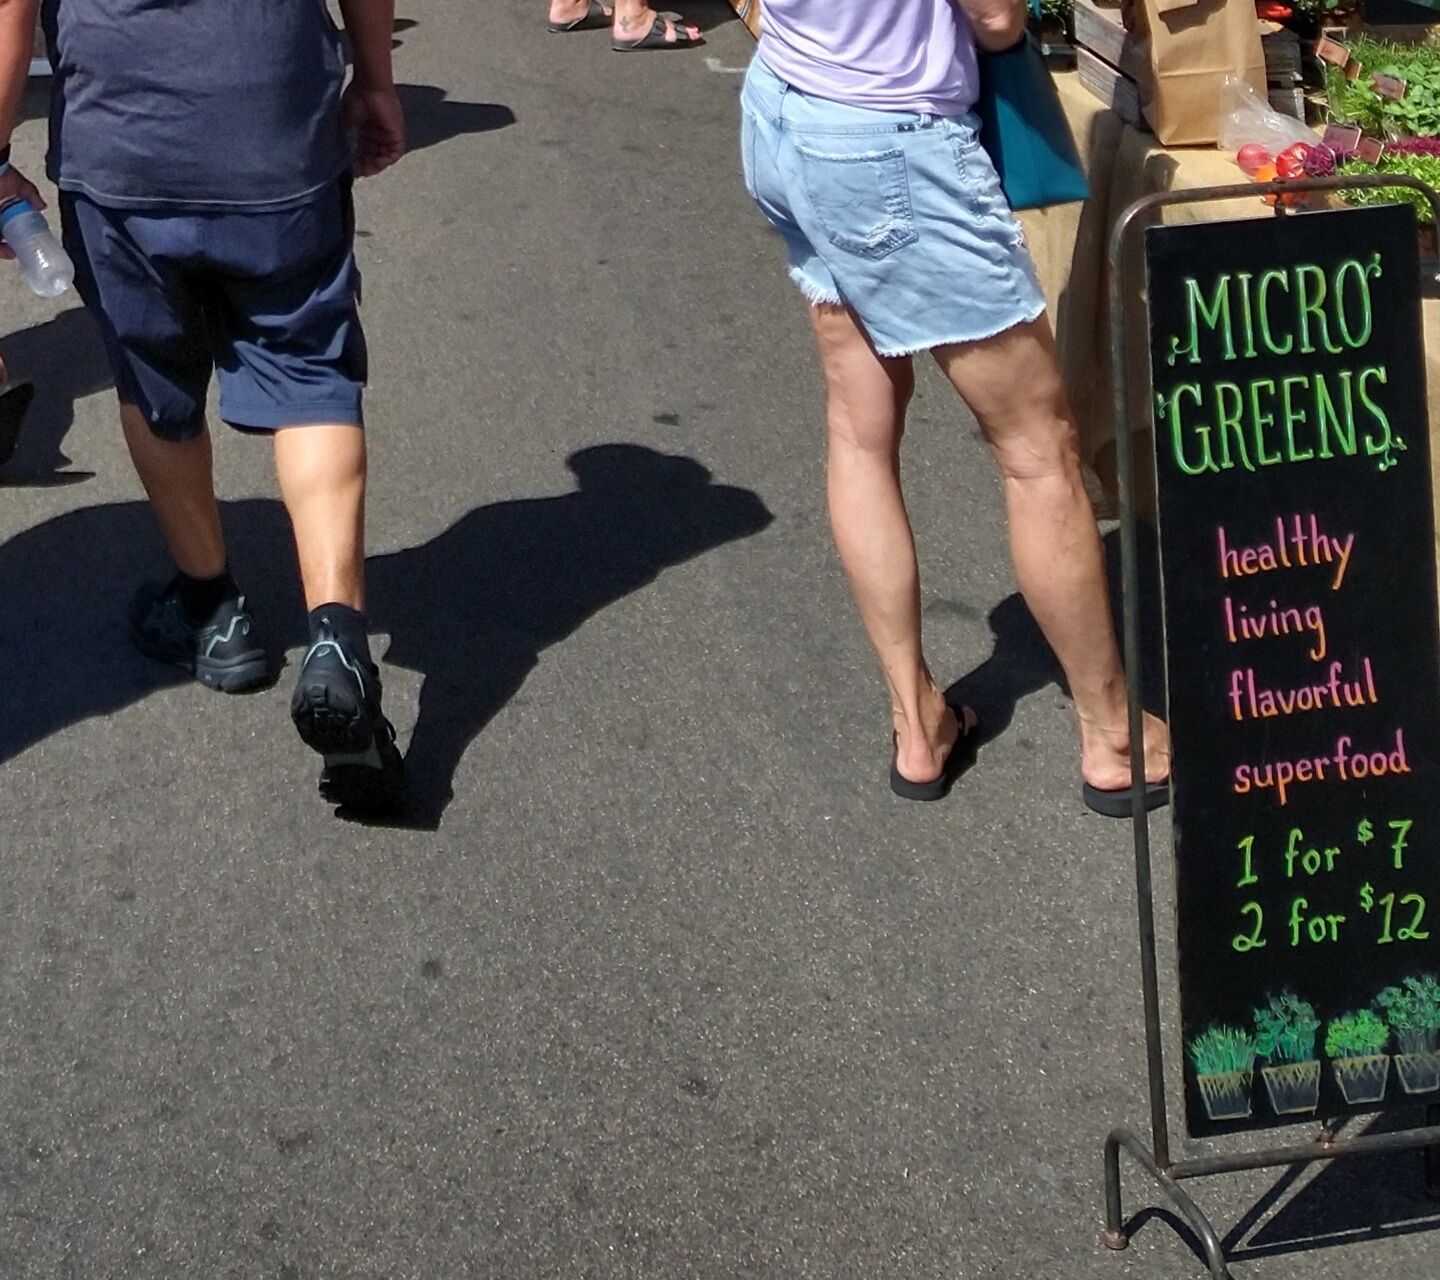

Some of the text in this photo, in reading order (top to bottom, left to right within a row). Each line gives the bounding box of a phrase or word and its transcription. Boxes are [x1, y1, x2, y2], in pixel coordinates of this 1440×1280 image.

[1172, 256, 1380, 365] MICRO
[1164, 366, 1400, 476] GREENS
[1218, 513, 1355, 591] healthy
[1224, 597, 1327, 661] living
[1228, 657, 1378, 721] flavorful
[1233, 728, 1411, 806] superfood
[1236, 835, 1259, 888] 1
[1284, 828, 1341, 878] for
[1232, 883, 1431, 953] 2 for $12
